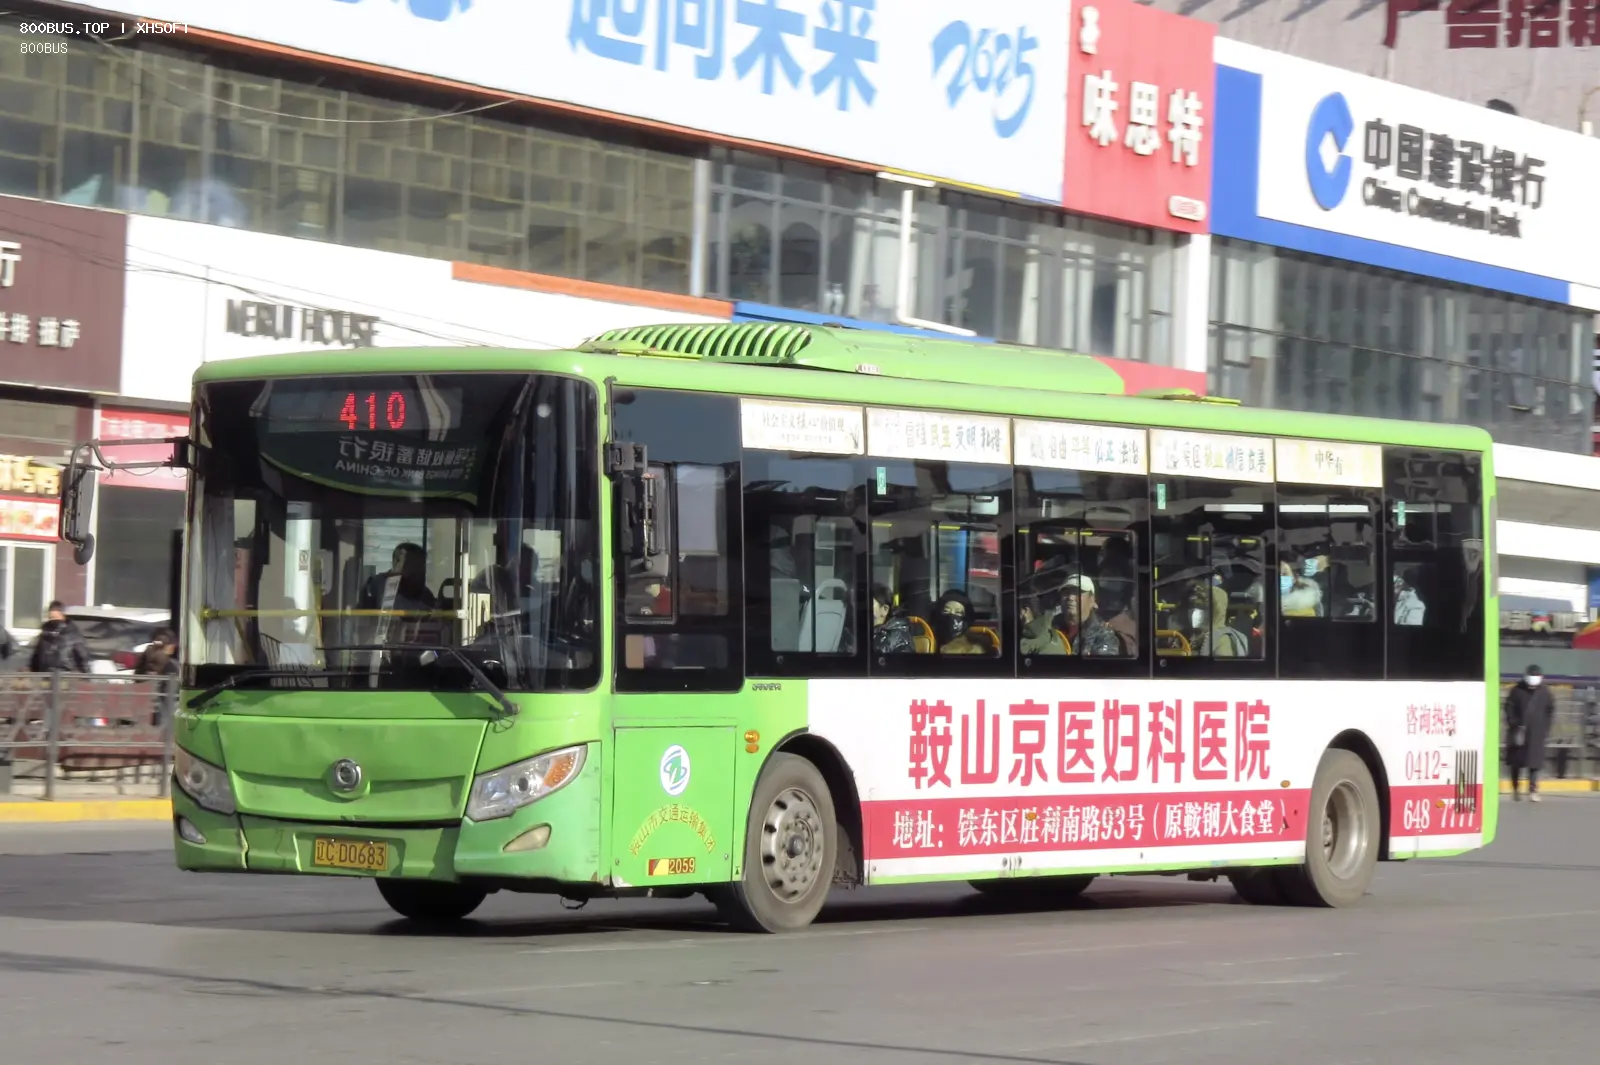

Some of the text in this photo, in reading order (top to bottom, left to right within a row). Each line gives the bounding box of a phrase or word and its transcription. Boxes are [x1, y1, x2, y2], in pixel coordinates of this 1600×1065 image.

[1082, 70, 1204, 167] 味思特
[1363, 117, 1547, 210] 中国建设银行
[339, 392, 406, 430] 410
[908, 699, 1271, 789] 鞍山京医妇科医院
[1403, 798, 1431, 830] 648
[669, 857, 695, 875] 2059
